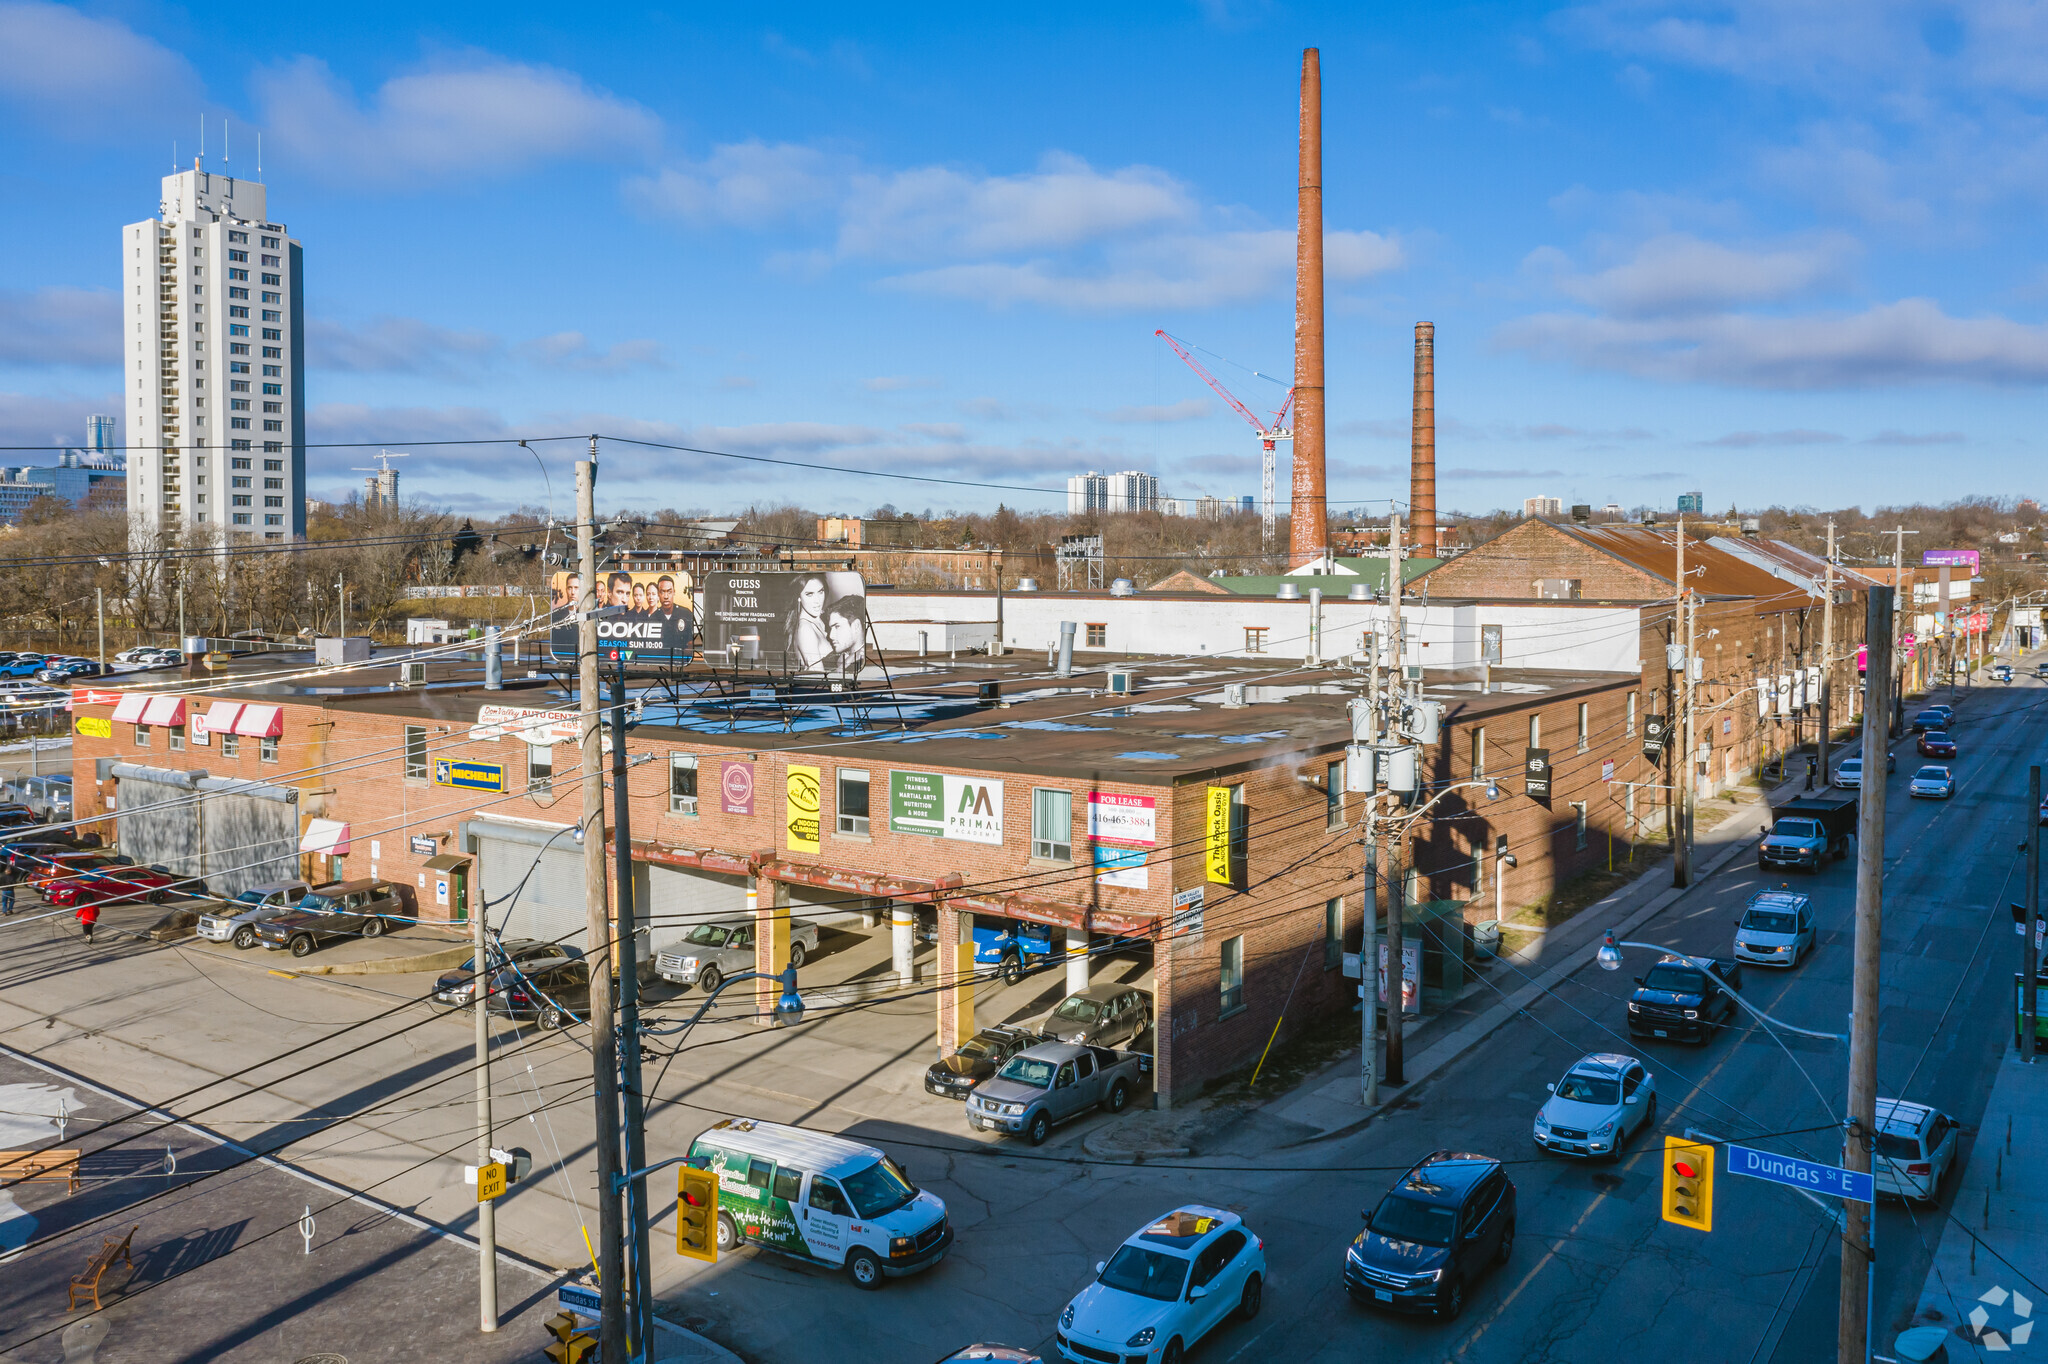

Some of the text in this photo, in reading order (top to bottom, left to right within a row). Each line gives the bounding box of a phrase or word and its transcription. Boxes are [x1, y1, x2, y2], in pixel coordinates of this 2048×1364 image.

[729, 579, 761, 589] GUESS
[733, 597, 758, 608] NOIR
[597, 621, 663, 638] OOKIE
[599, 640, 628, 648] SEASON
[645, 641, 663, 649] 10:00
[831, 684, 842, 692] 666
[522, 710, 546, 719] AUTO
[548, 712, 581, 721] CENT
[452, 768, 500, 783] MICHELIN
[904, 784, 931, 792] TRAINING
[899, 792, 937, 801] MARTIAL ARTS
[1100, 795, 1143, 807] FOR LEASE
[904, 801, 932, 809] NUTRITION
[1214, 792, 1222, 816] Oasis
[950, 817, 1001, 831] PRIMAL
[1213, 819, 1221, 842] Rock
[1384, 947, 1415, 958] PENE
[486, 1168, 497, 1180] NO
[716, 1164, 746, 1181] Canadian
[1747, 1151, 1853, 1191] Dundas St E
[483, 1182, 500, 1196] EXIT
[759, 1210, 771, 1226] the
[771, 1214, 795, 1235] writing
[746, 1225, 760, 1236] OFF
[762, 1226, 774, 1240] the
[562, 1292, 587, 1306] Dundas
